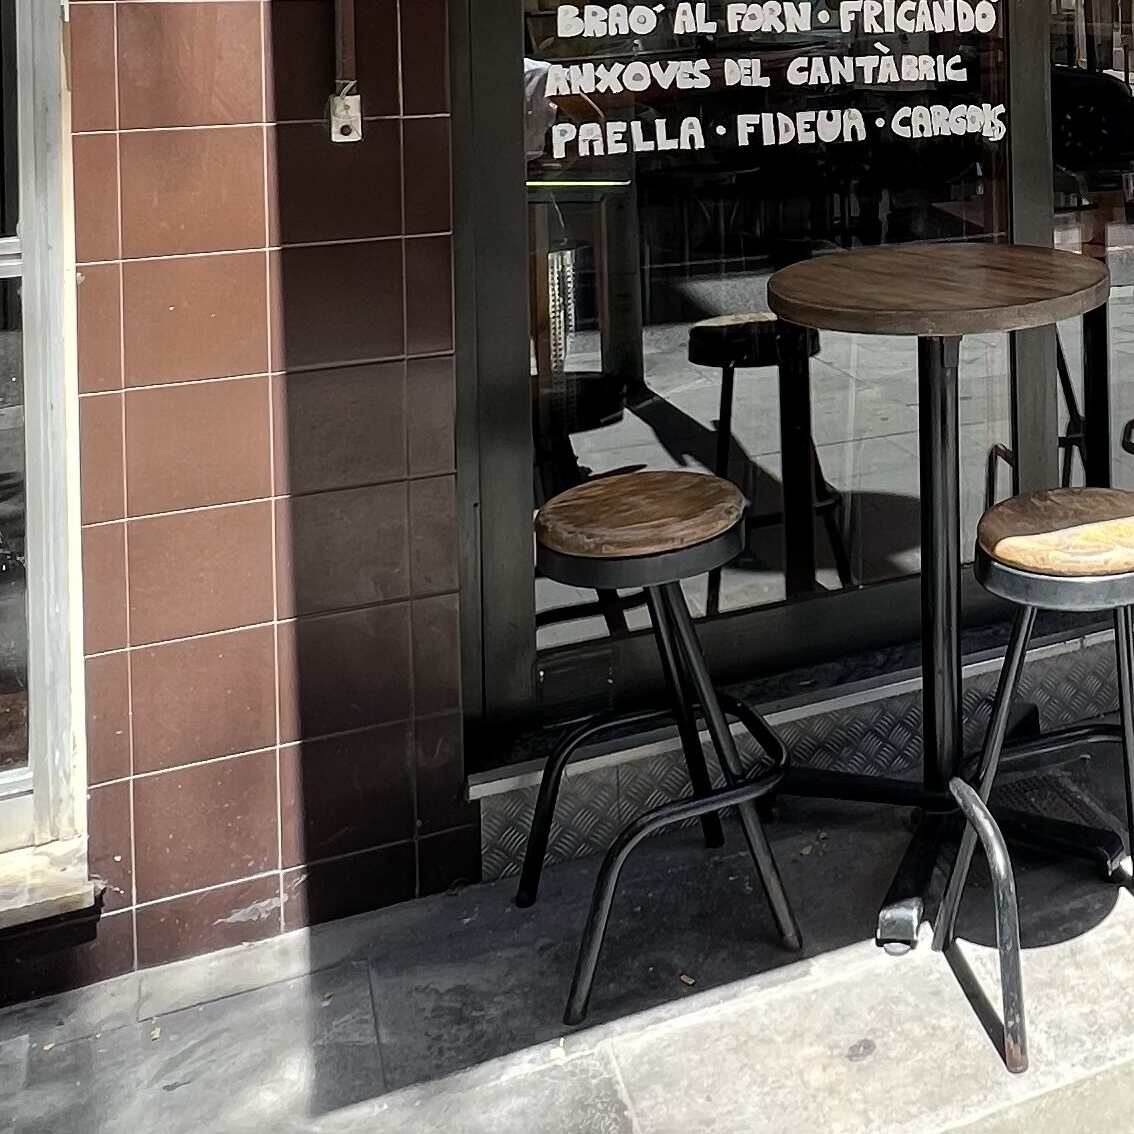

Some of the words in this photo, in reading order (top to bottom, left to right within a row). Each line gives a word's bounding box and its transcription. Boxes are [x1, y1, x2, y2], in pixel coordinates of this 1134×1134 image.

[673, 2, 717, 35] AL
[727, 1, 813, 34] FORN
[544, 58, 711, 97] ANXOVES
[724, 57, 770, 88] DEL
[786, 41, 968, 86] CANTÀBRIC
[551, 116, 705, 159] PAELLA
[736, 108, 867, 147] FIDEUA
